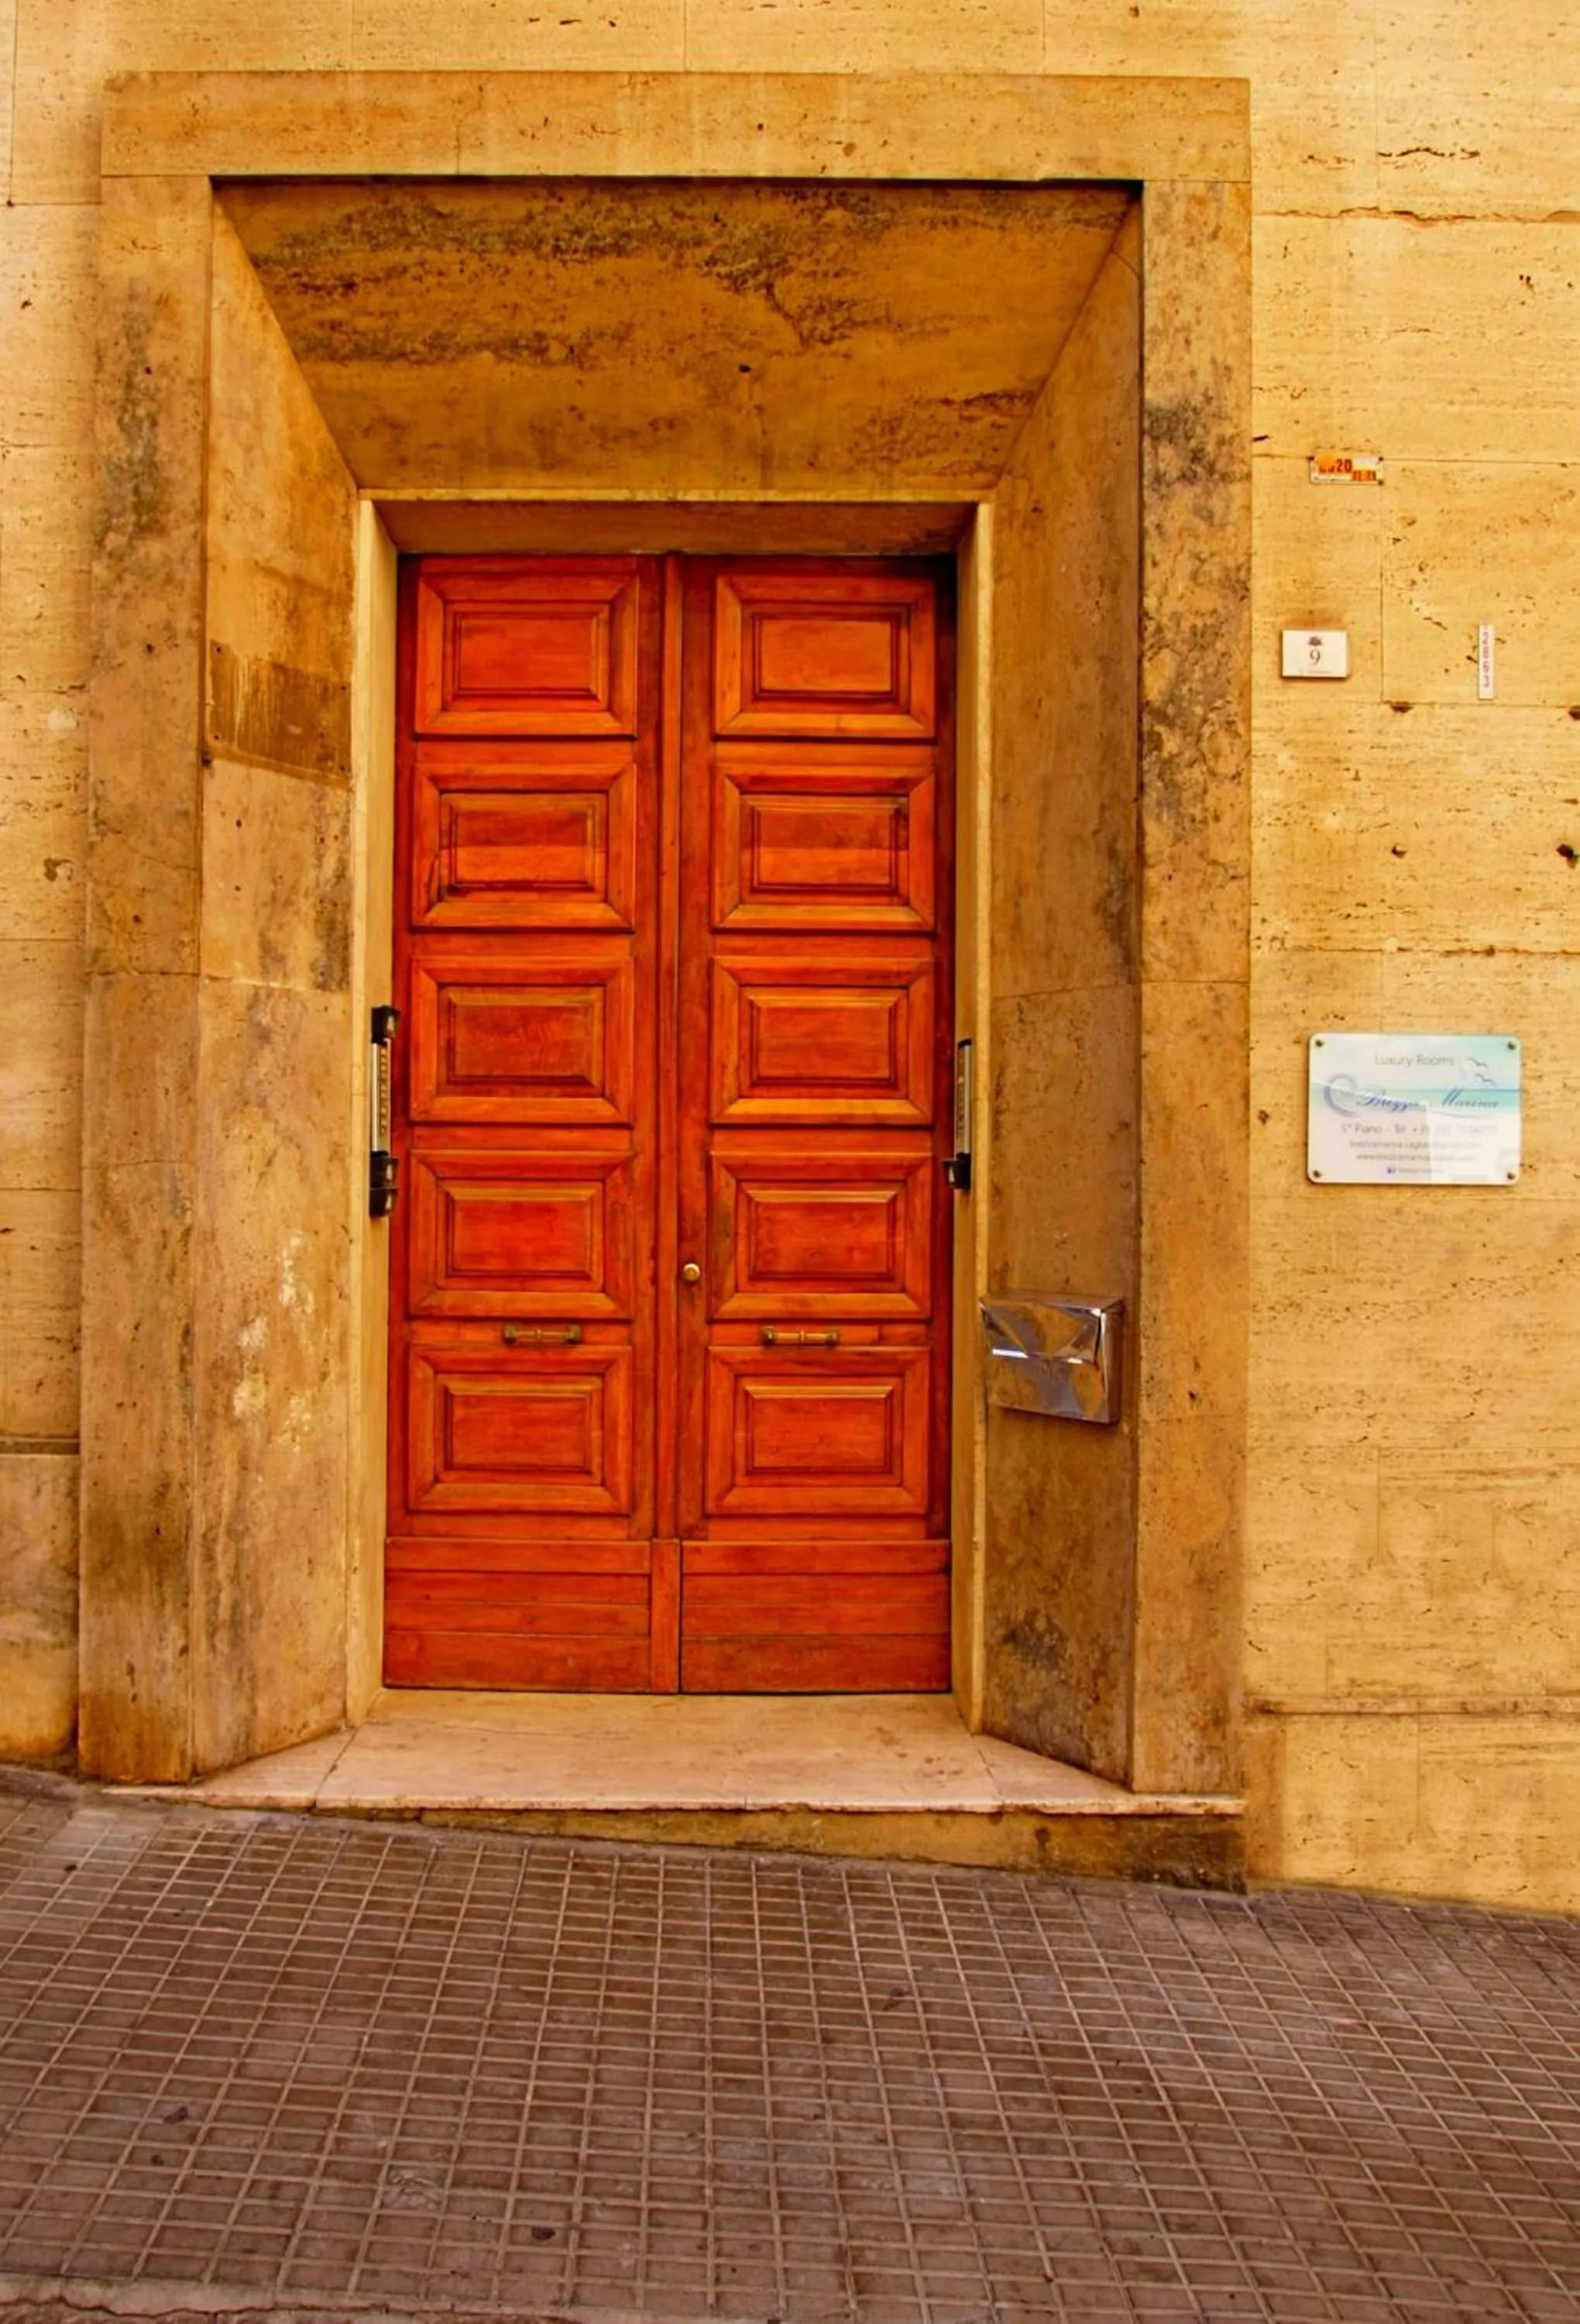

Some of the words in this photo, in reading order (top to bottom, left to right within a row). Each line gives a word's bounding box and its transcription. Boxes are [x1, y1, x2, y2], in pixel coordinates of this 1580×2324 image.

[1310, 649, 1321, 665] 9
[1374, 1054, 1413, 1067] Luxury
[1416, 1054, 1455, 1067] Rooms
